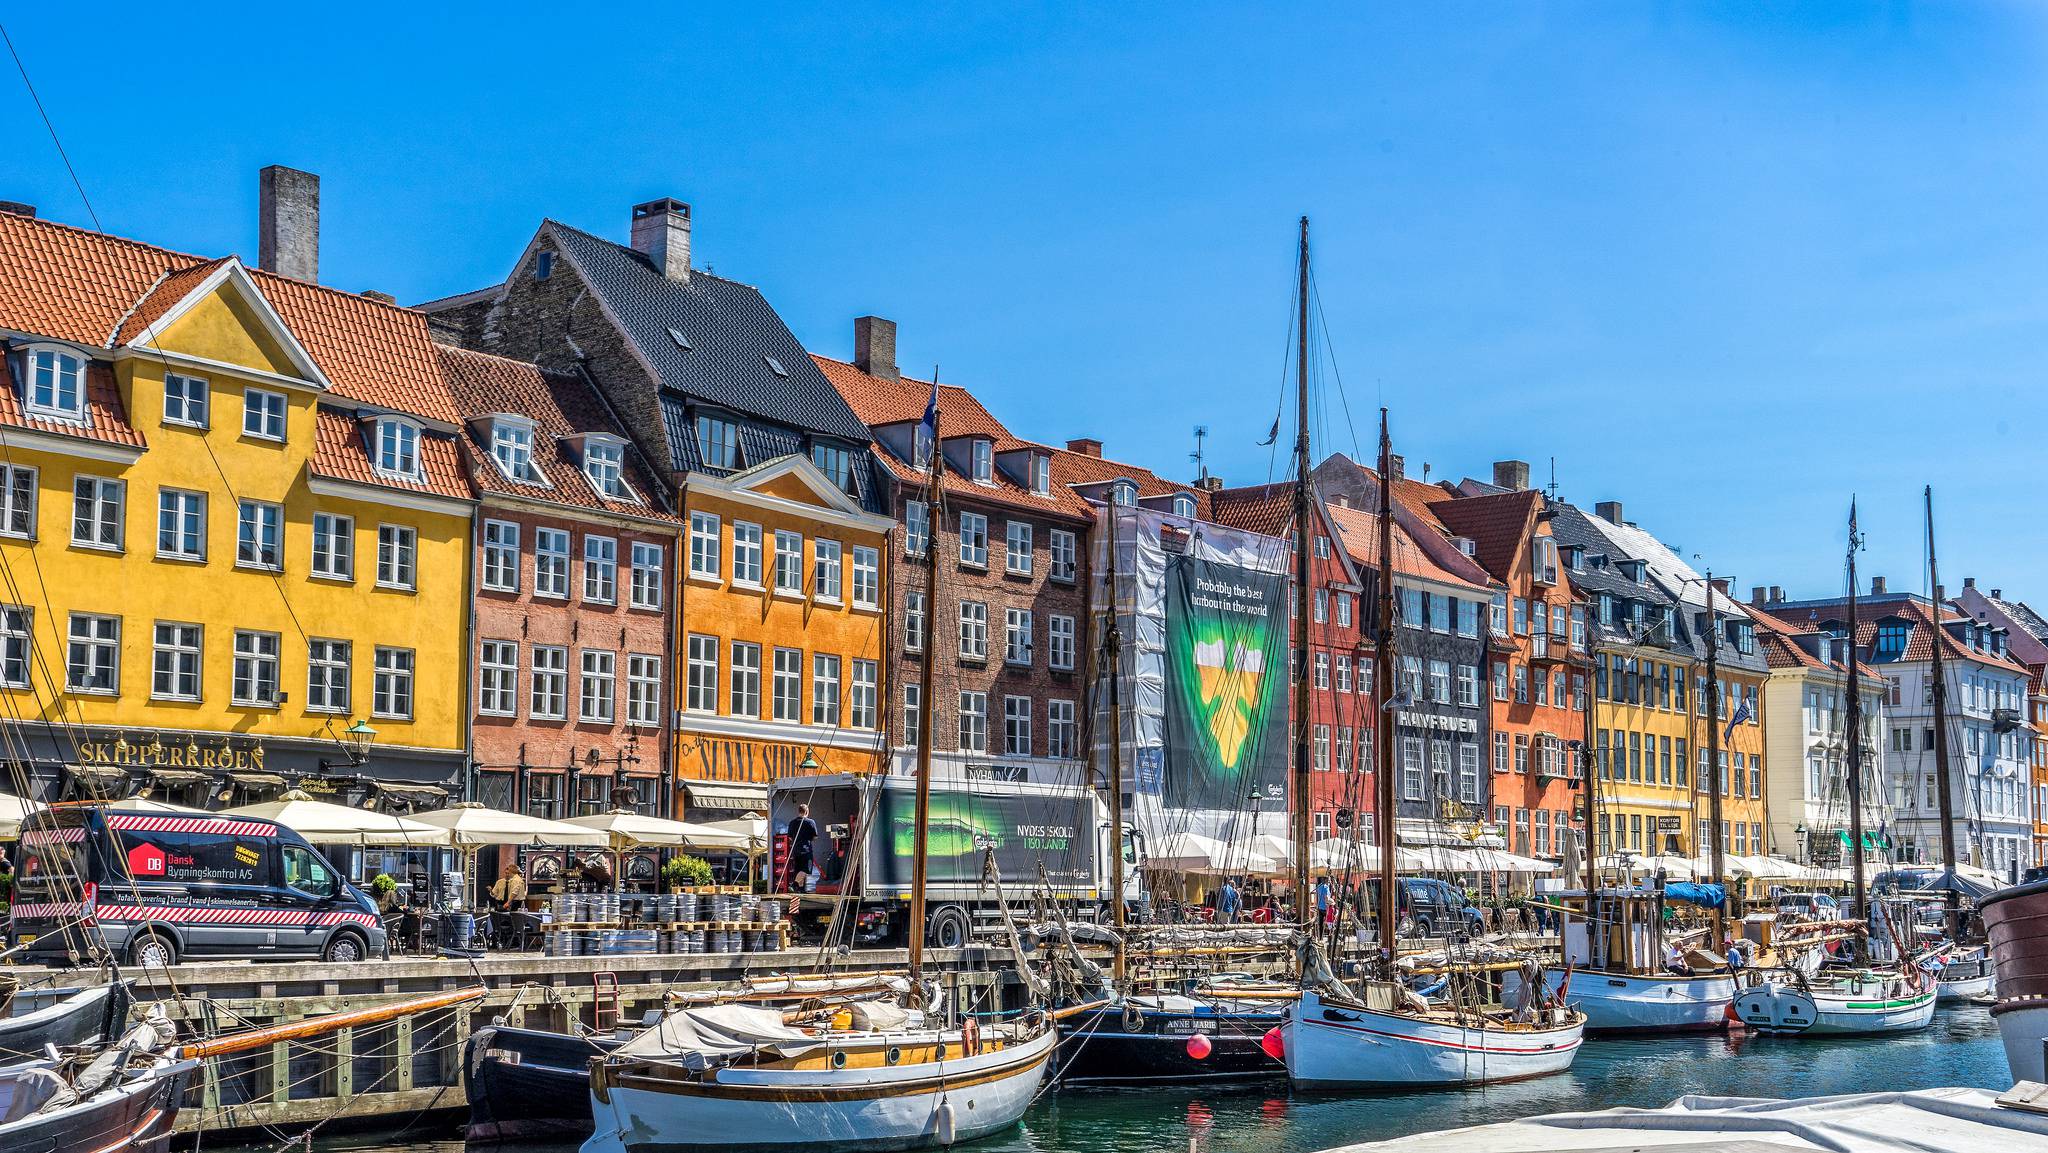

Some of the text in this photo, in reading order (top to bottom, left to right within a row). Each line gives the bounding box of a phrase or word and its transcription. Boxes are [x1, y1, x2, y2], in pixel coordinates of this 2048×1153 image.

[1196, 577, 1263, 600] Probably the best
[1191, 592, 1268, 617] harbour in the world
[1397, 710, 1479, 733] HAVFRUEN
[80, 741, 265, 770] SKIPPERKROEN
[700, 739, 803, 783] SUNNY SIDE
[969, 769, 1004, 782] NYHAVN
[1017, 824, 1045, 837] NYDES
[147, 857, 162, 871] DB
[168, 853, 194, 865] Dansk
[167, 865, 254, 881] Bygningskontrol A/S
[170, 895, 189, 904] brand
[192, 896, 208, 905] vand
[210, 897, 259, 908] skimmelsanering
[1167, 1020, 1217, 1029] ANNE MARIE
